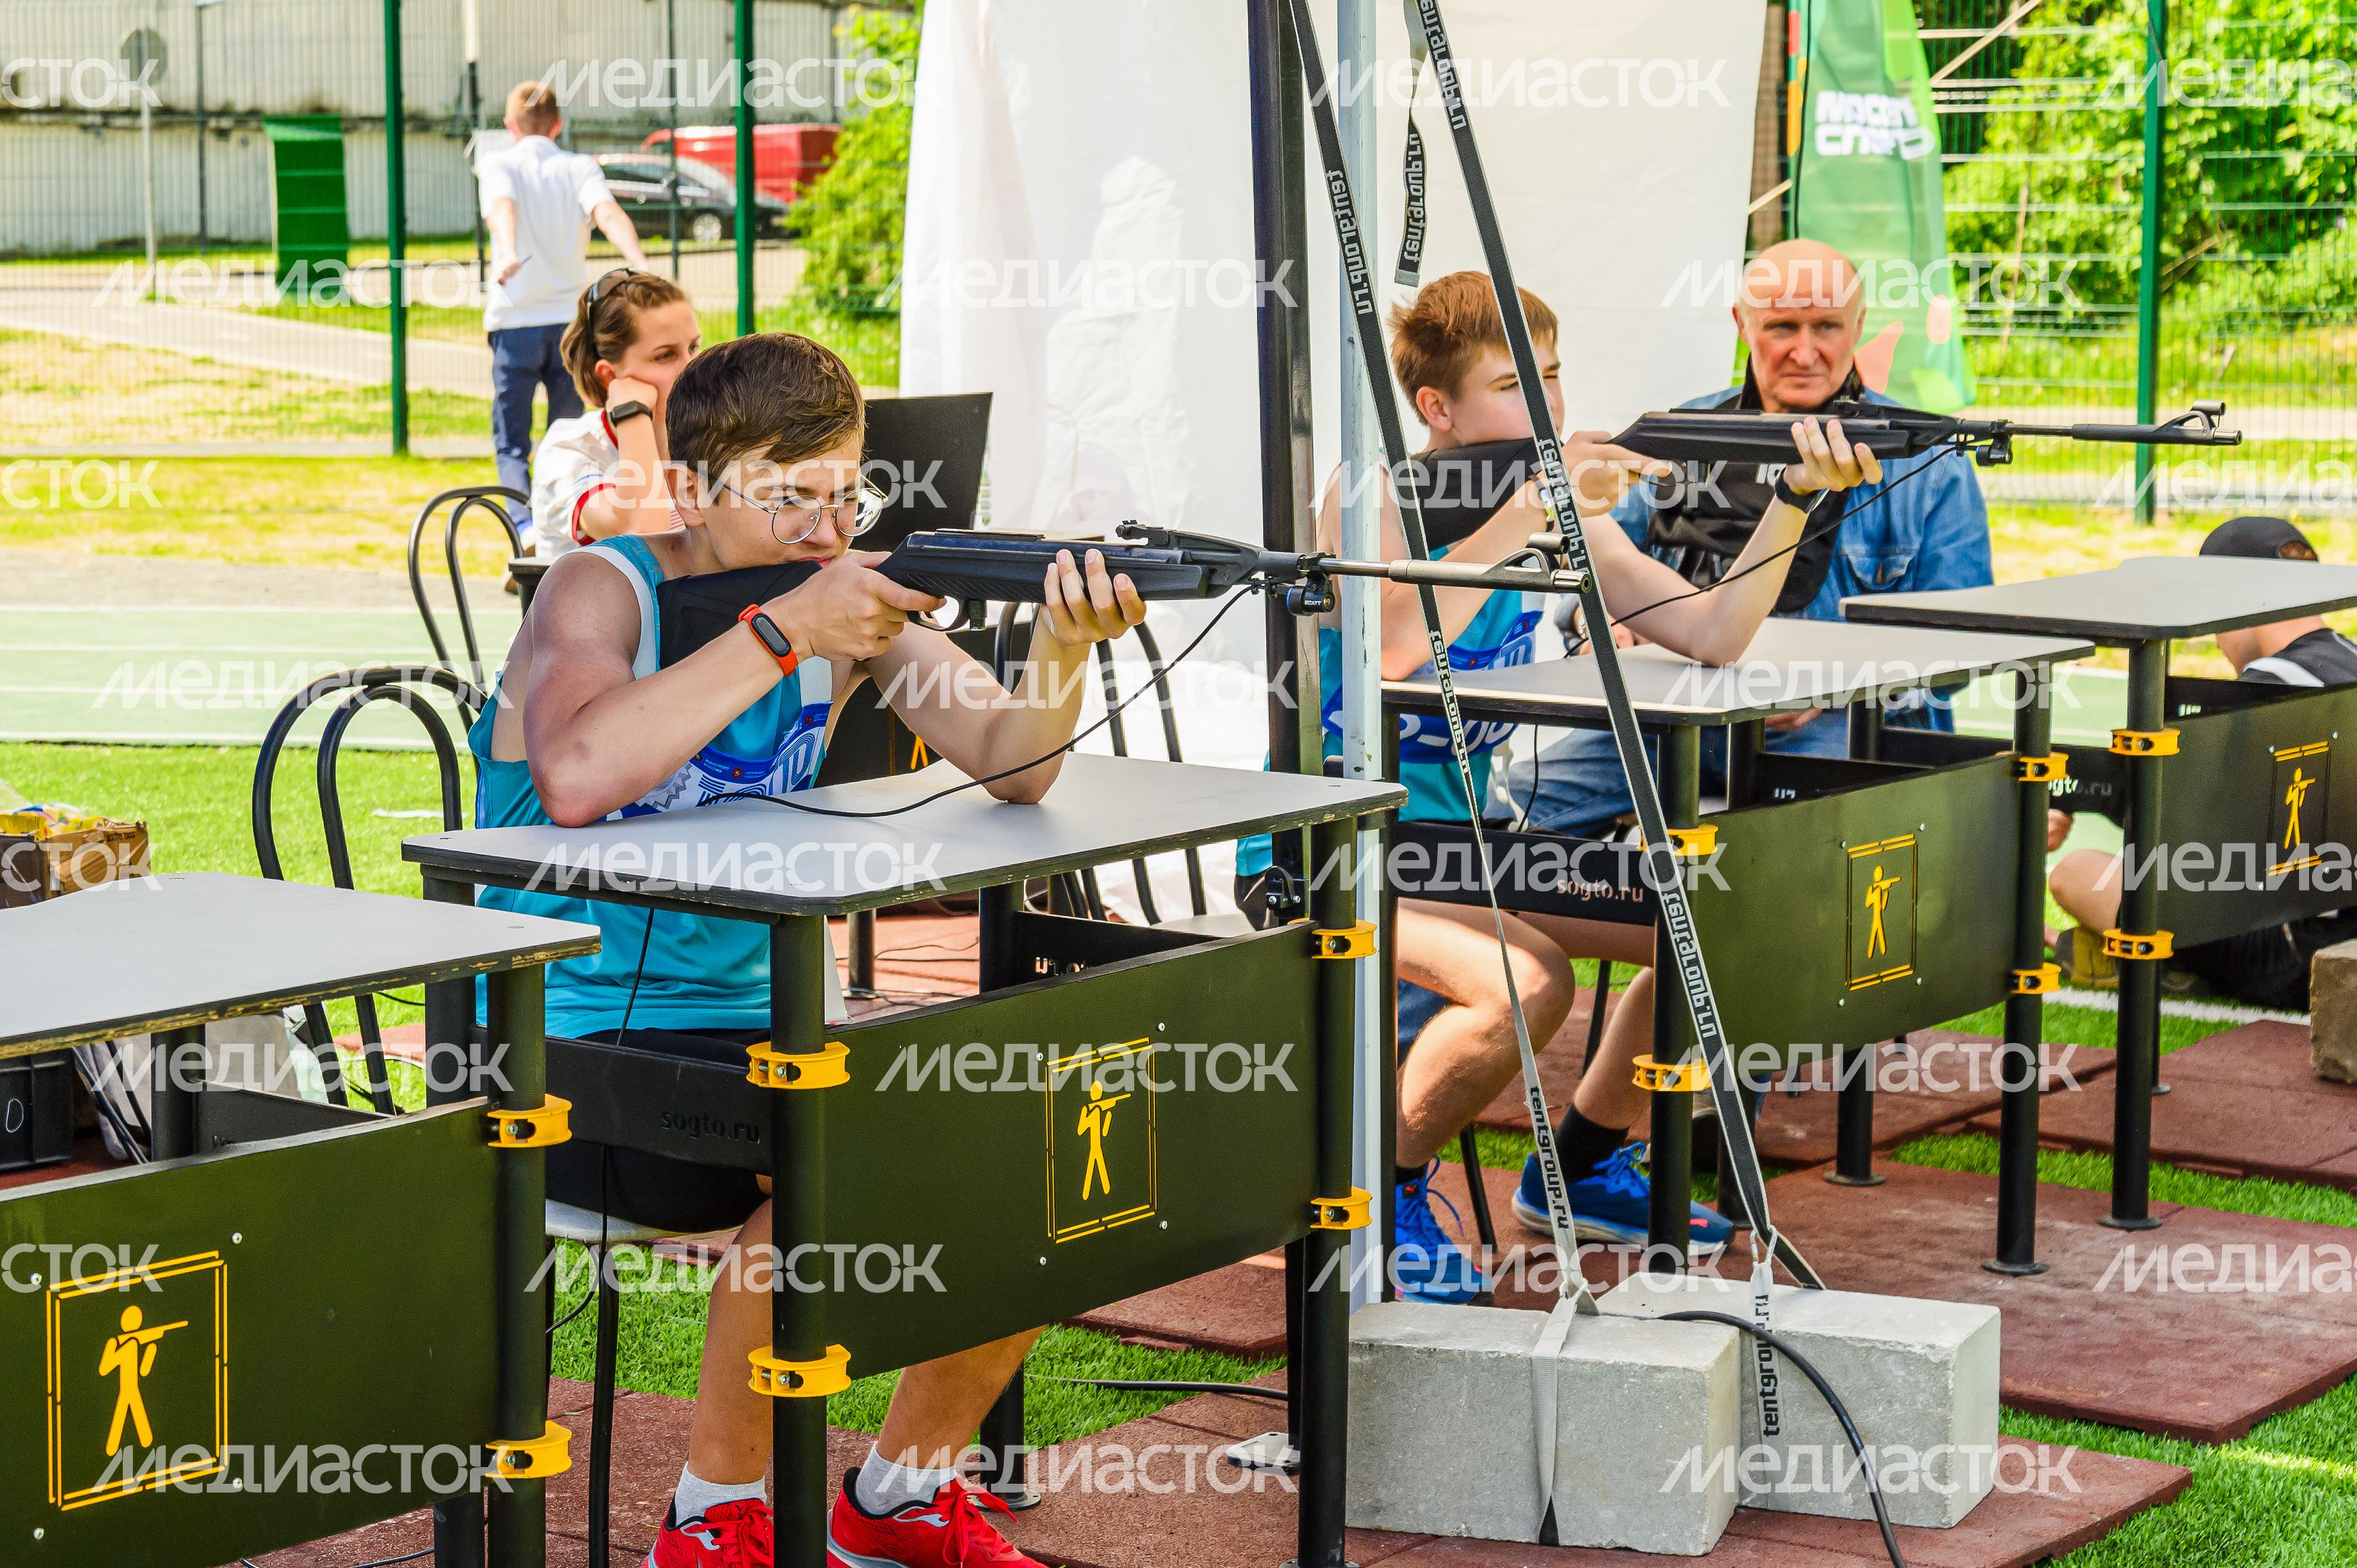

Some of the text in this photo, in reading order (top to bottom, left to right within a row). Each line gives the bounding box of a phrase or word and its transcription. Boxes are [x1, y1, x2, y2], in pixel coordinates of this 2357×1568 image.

[1557, 879, 1644, 902] sogto.ru
[661, 1111, 760, 1144] sogto.ru
[1530, 1085, 1569, 1229] tentgroup.ru
